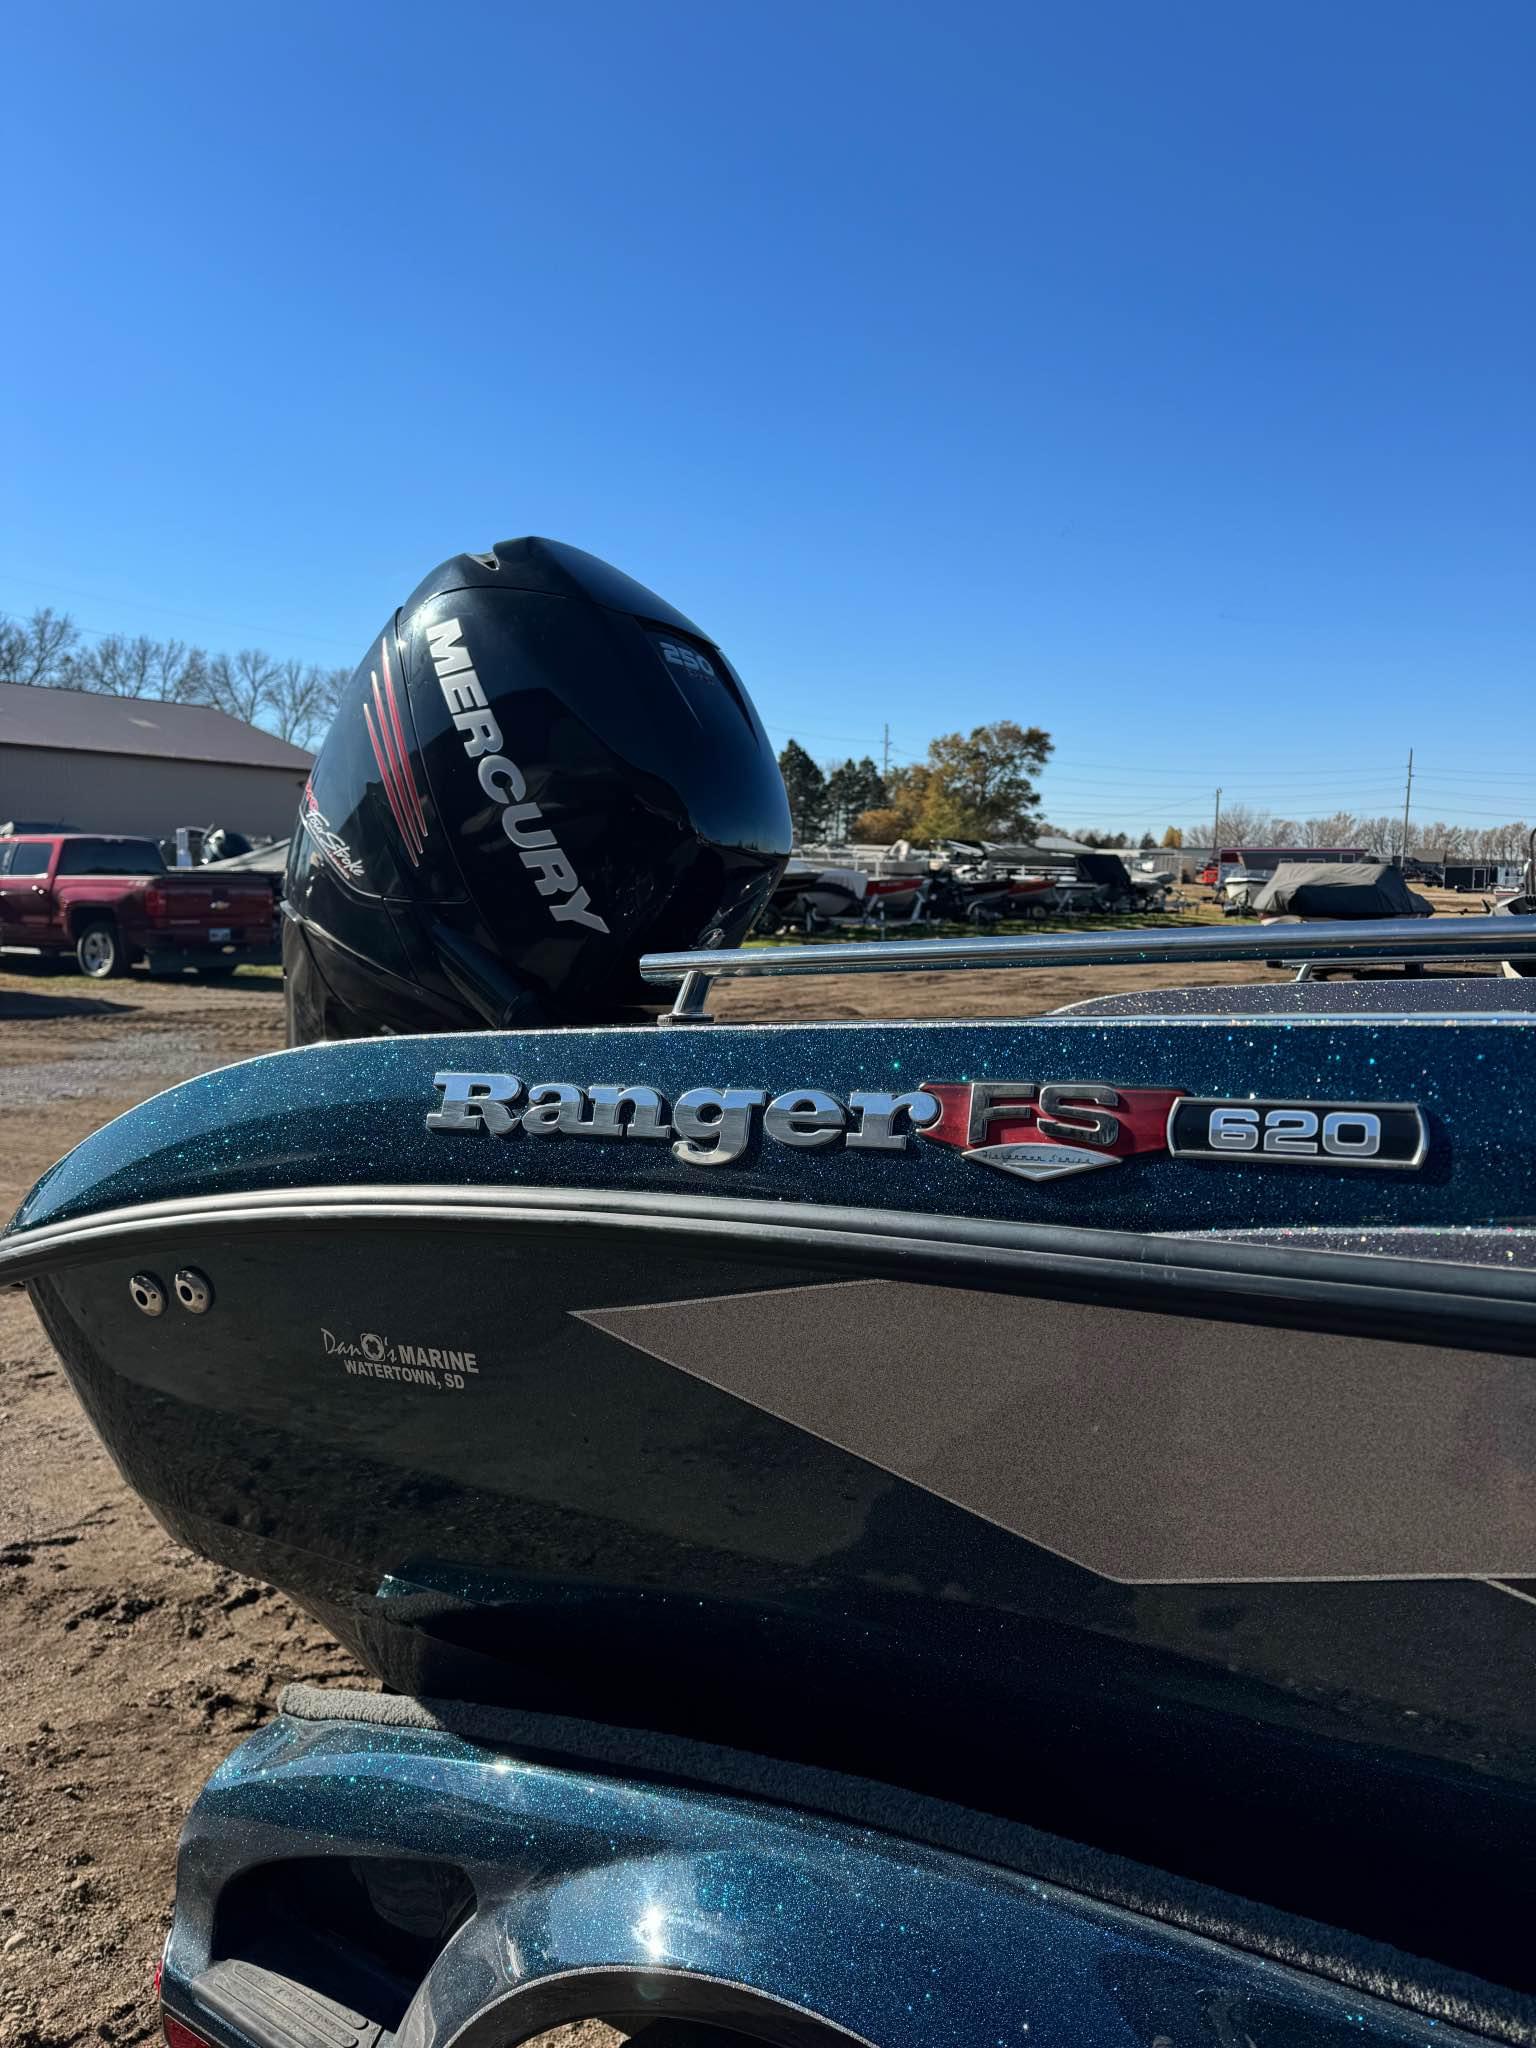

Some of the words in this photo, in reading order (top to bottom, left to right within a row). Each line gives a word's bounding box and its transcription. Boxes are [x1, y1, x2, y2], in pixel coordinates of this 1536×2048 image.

[659, 641, 715, 676] 250
[426, 618, 610, 934] MERCURY
[426, 1072, 942, 1166] Ranger
[967, 1083, 1118, 1146] FS
[1208, 1108, 1381, 1157] 620
[344, 1360, 442, 1390] WATERTOWN,
[444, 1373, 465, 1389] SD
[398, 1345, 479, 1374] MARINE
